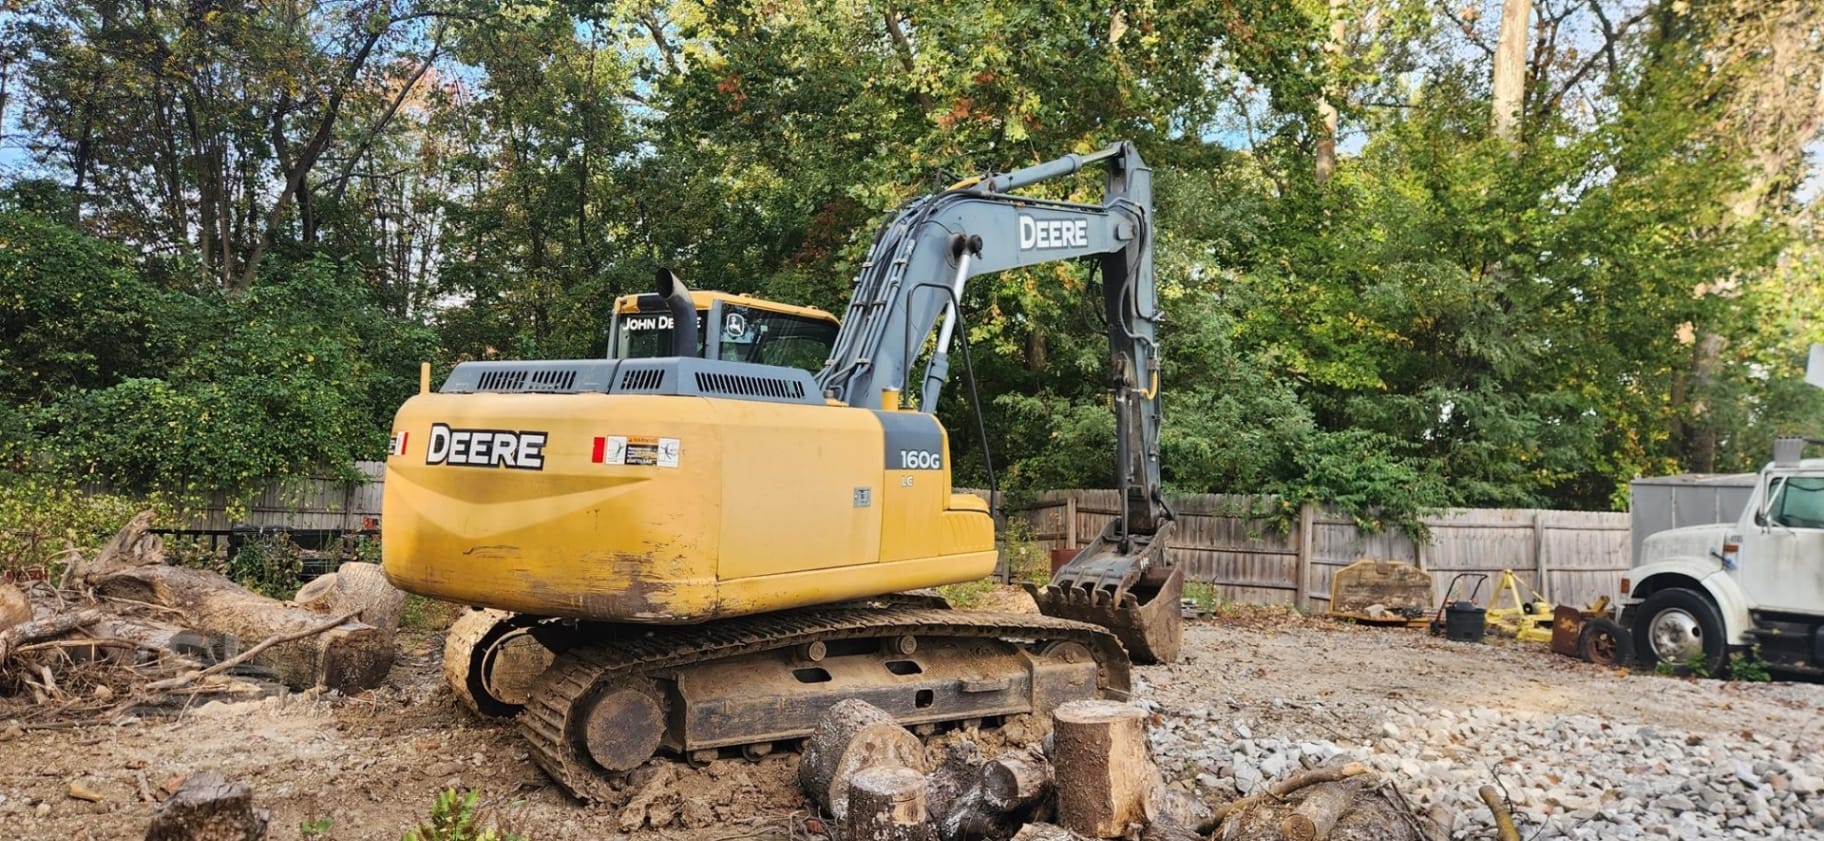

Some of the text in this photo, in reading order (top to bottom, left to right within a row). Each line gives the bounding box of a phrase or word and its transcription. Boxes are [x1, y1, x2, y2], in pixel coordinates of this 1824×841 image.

[1019, 214, 1088, 250] DEERE
[623, 316, 702, 330] JOHN DEE
[427, 424, 546, 469] DEERE
[901, 450, 940, 469] 160G
